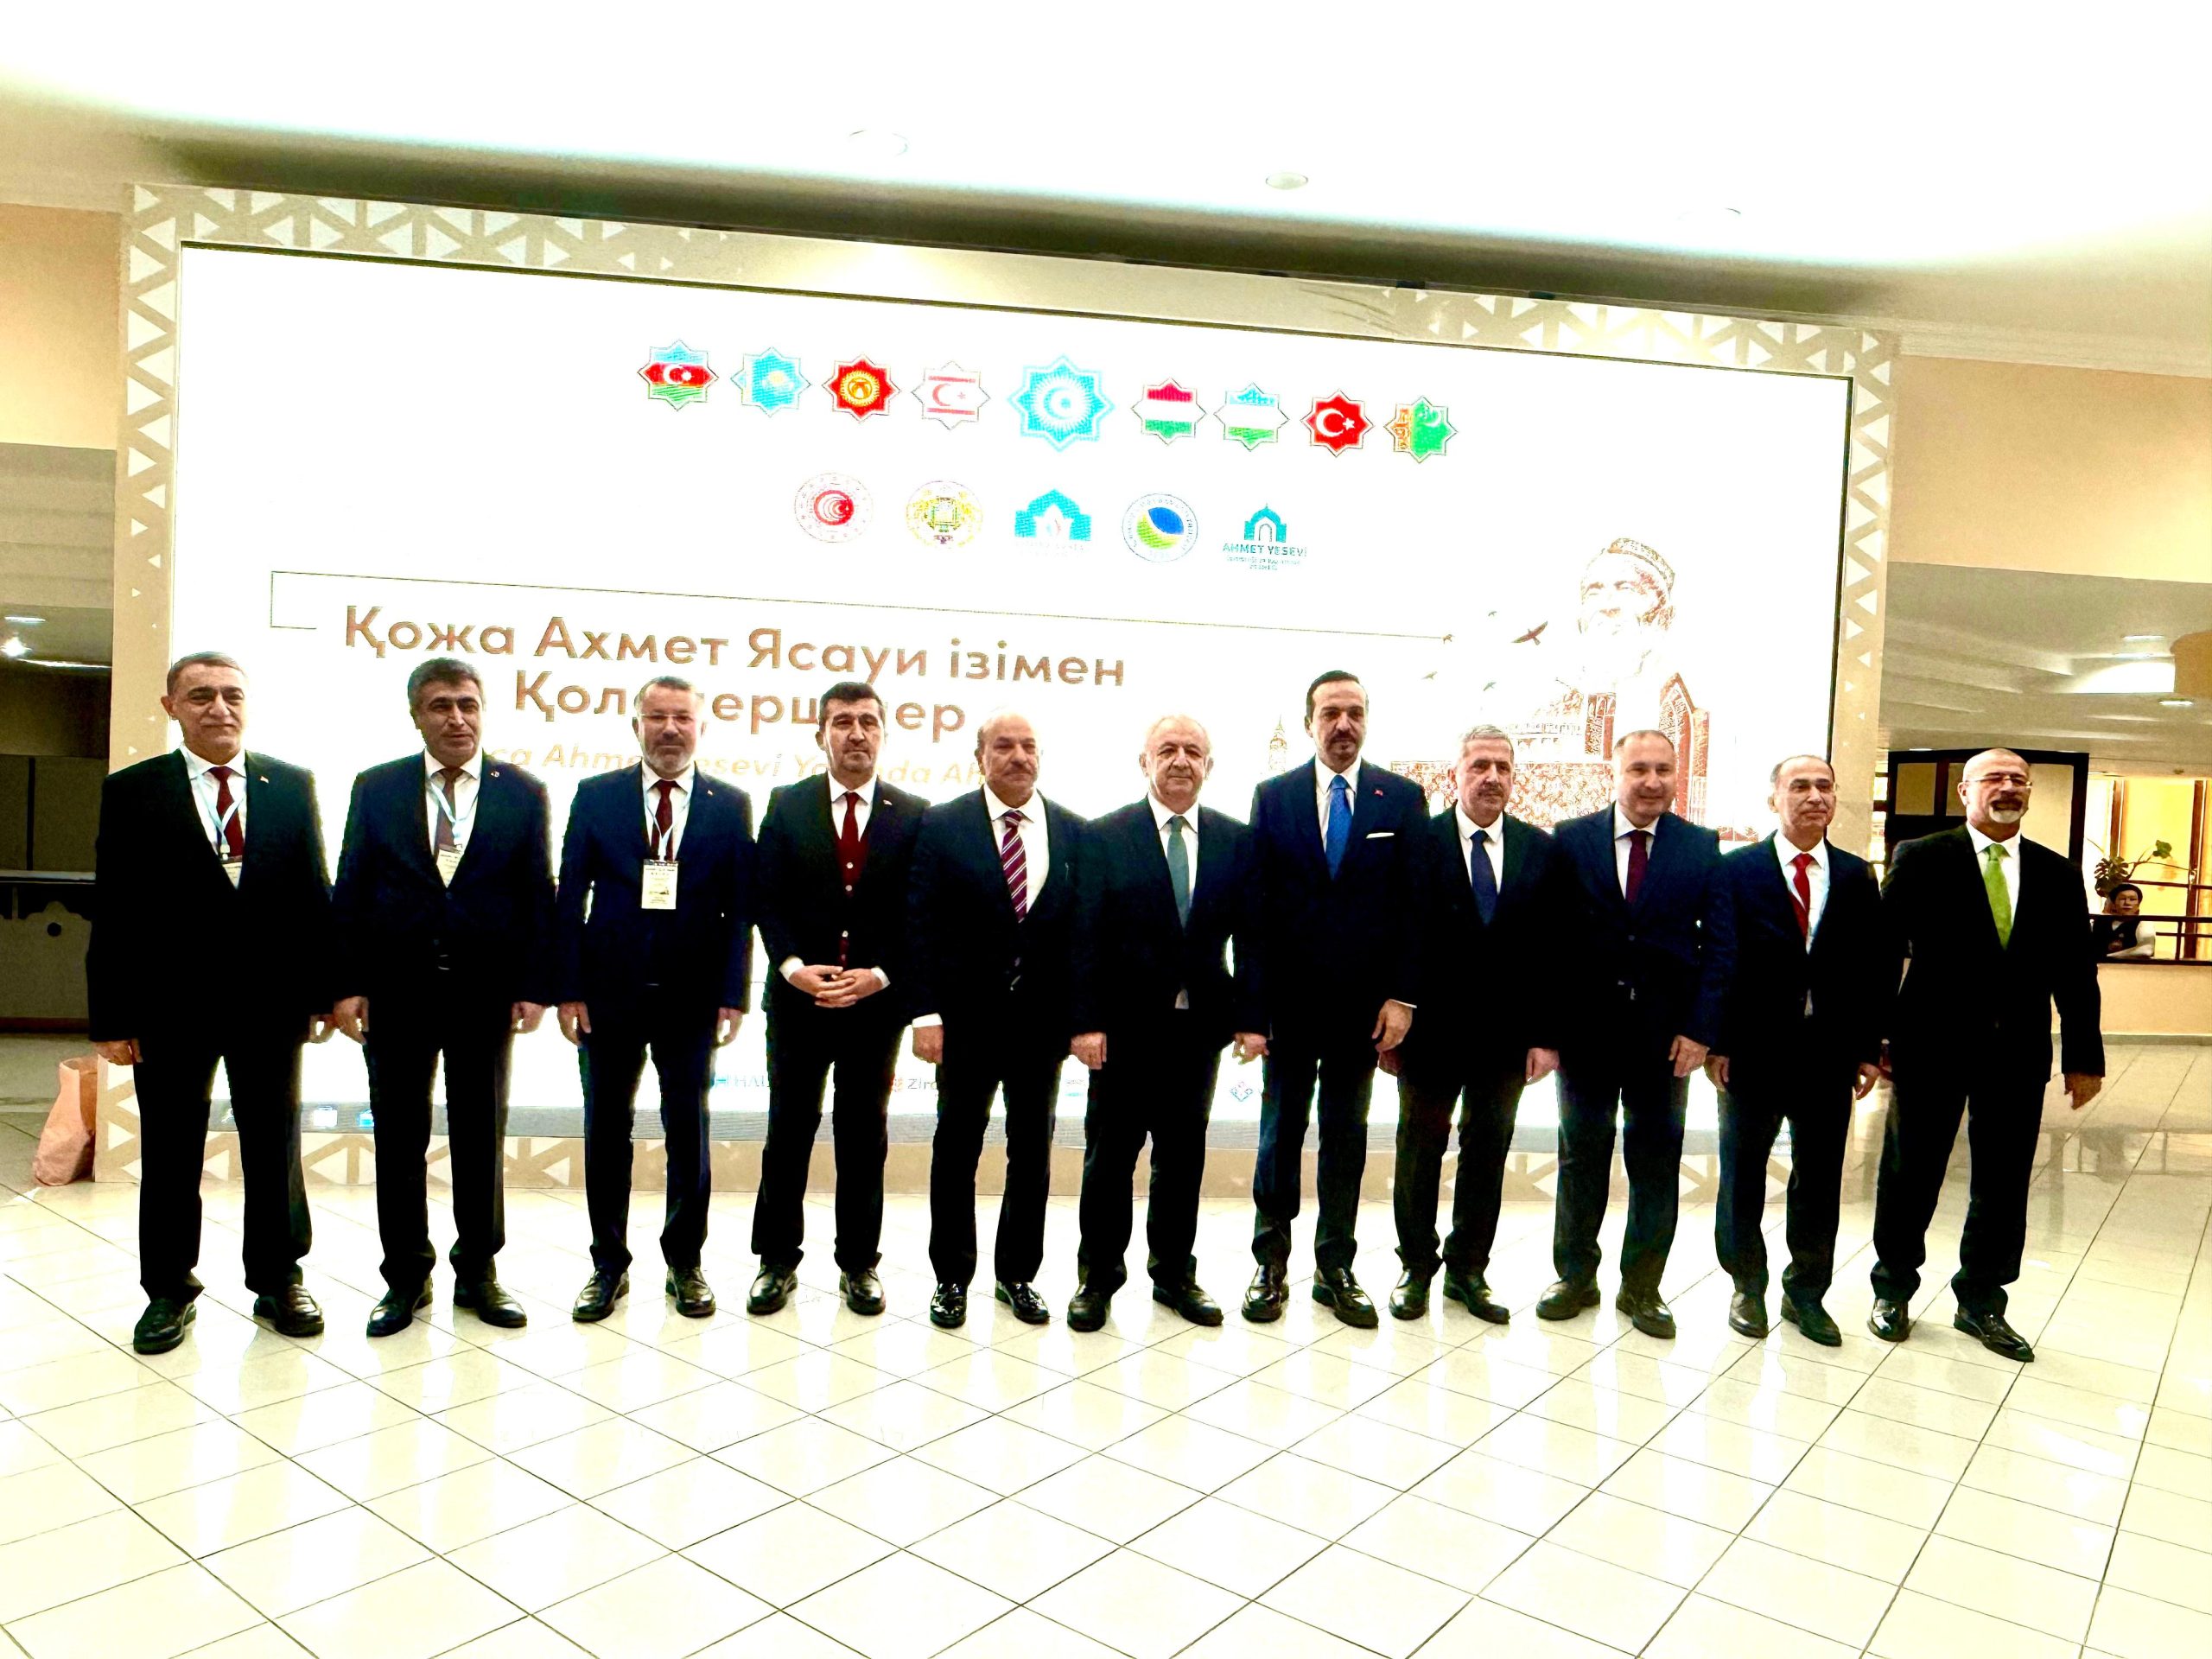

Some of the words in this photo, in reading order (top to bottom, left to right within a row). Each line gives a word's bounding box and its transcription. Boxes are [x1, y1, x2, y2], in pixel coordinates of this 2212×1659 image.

[1222, 543, 1265, 554] AHMET
[345, 605, 515, 659] Қожа
[533, 616, 729, 666] Ахмет
[747, 627, 927, 684] Ясауи
[950, 637, 1124, 687] ізімен
